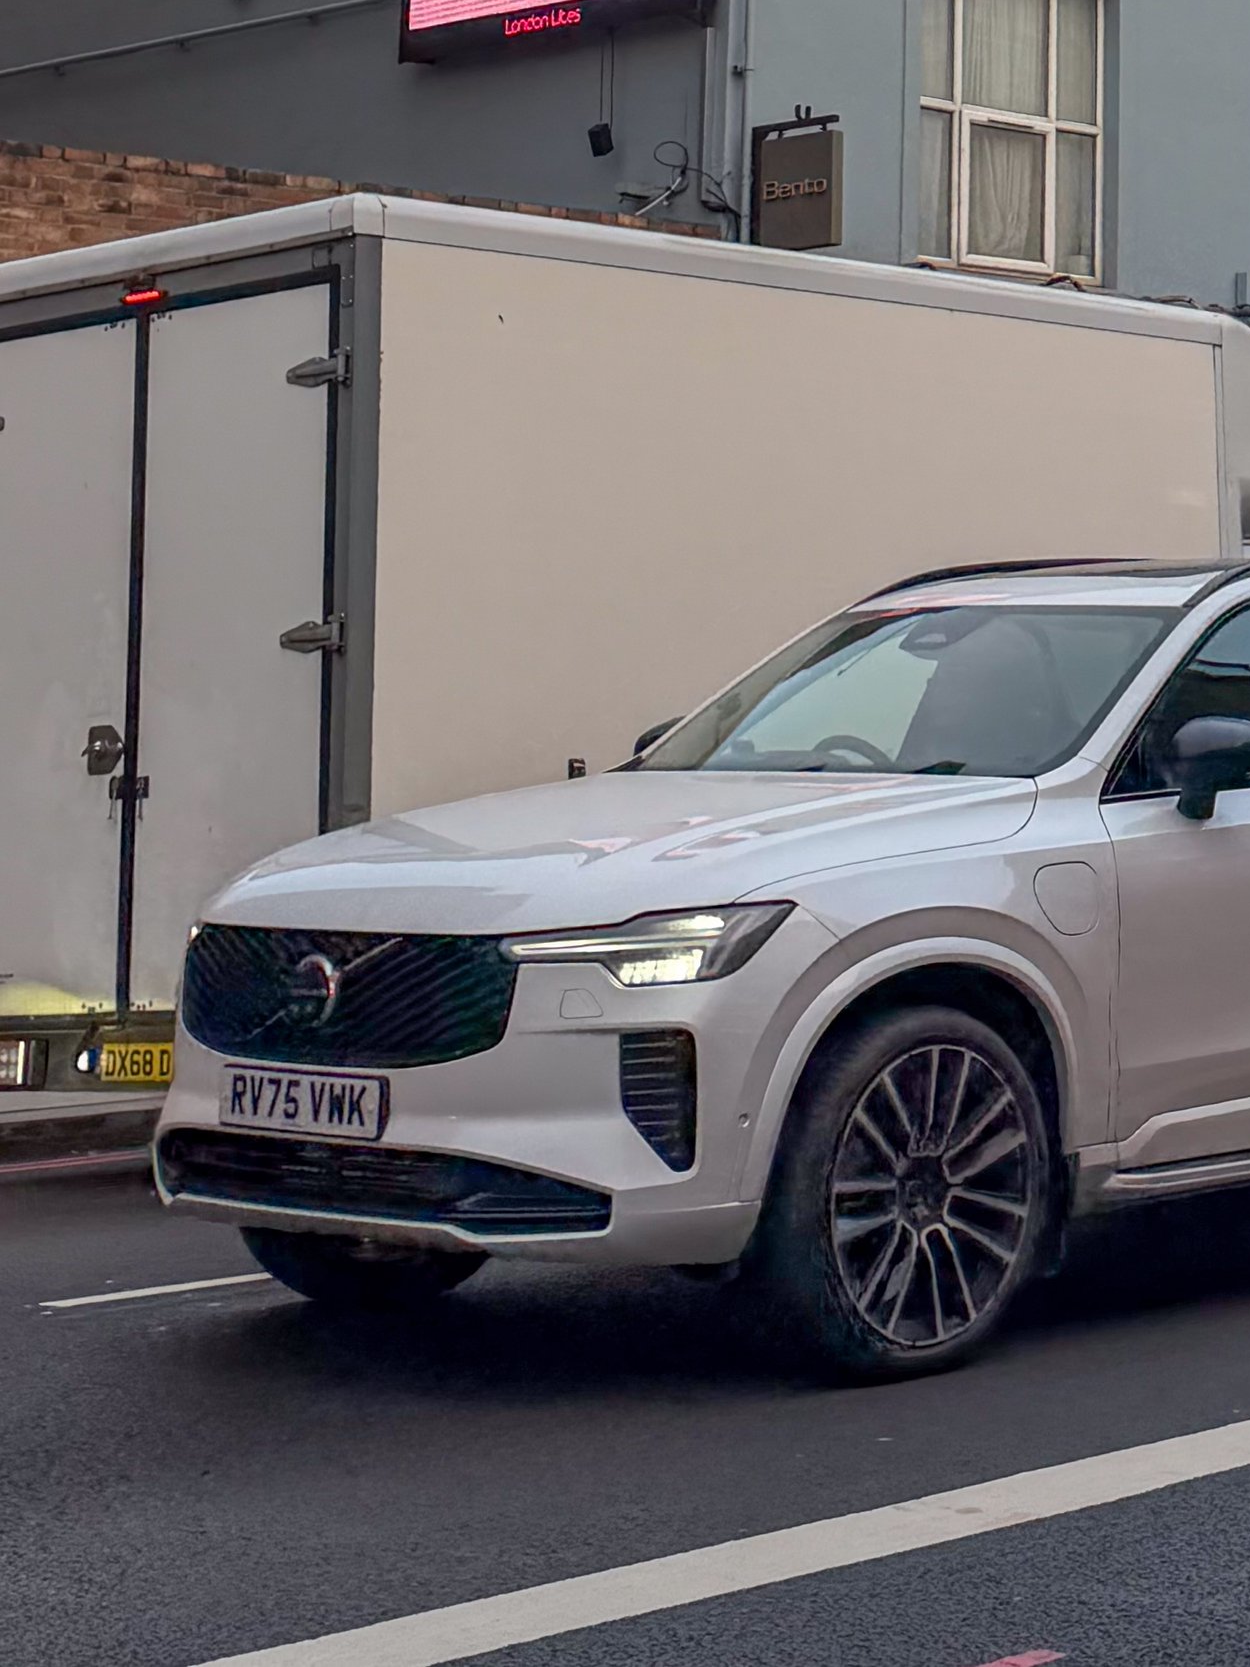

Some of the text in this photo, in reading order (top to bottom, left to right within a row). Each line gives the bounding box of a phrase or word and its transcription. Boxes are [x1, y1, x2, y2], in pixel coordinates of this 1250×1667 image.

[505, 15, 549, 35] London
[763, 178, 827, 201] Bento
[105, 1049, 153, 1077] DX68
[231, 1074, 366, 1127] RV75 VWK
